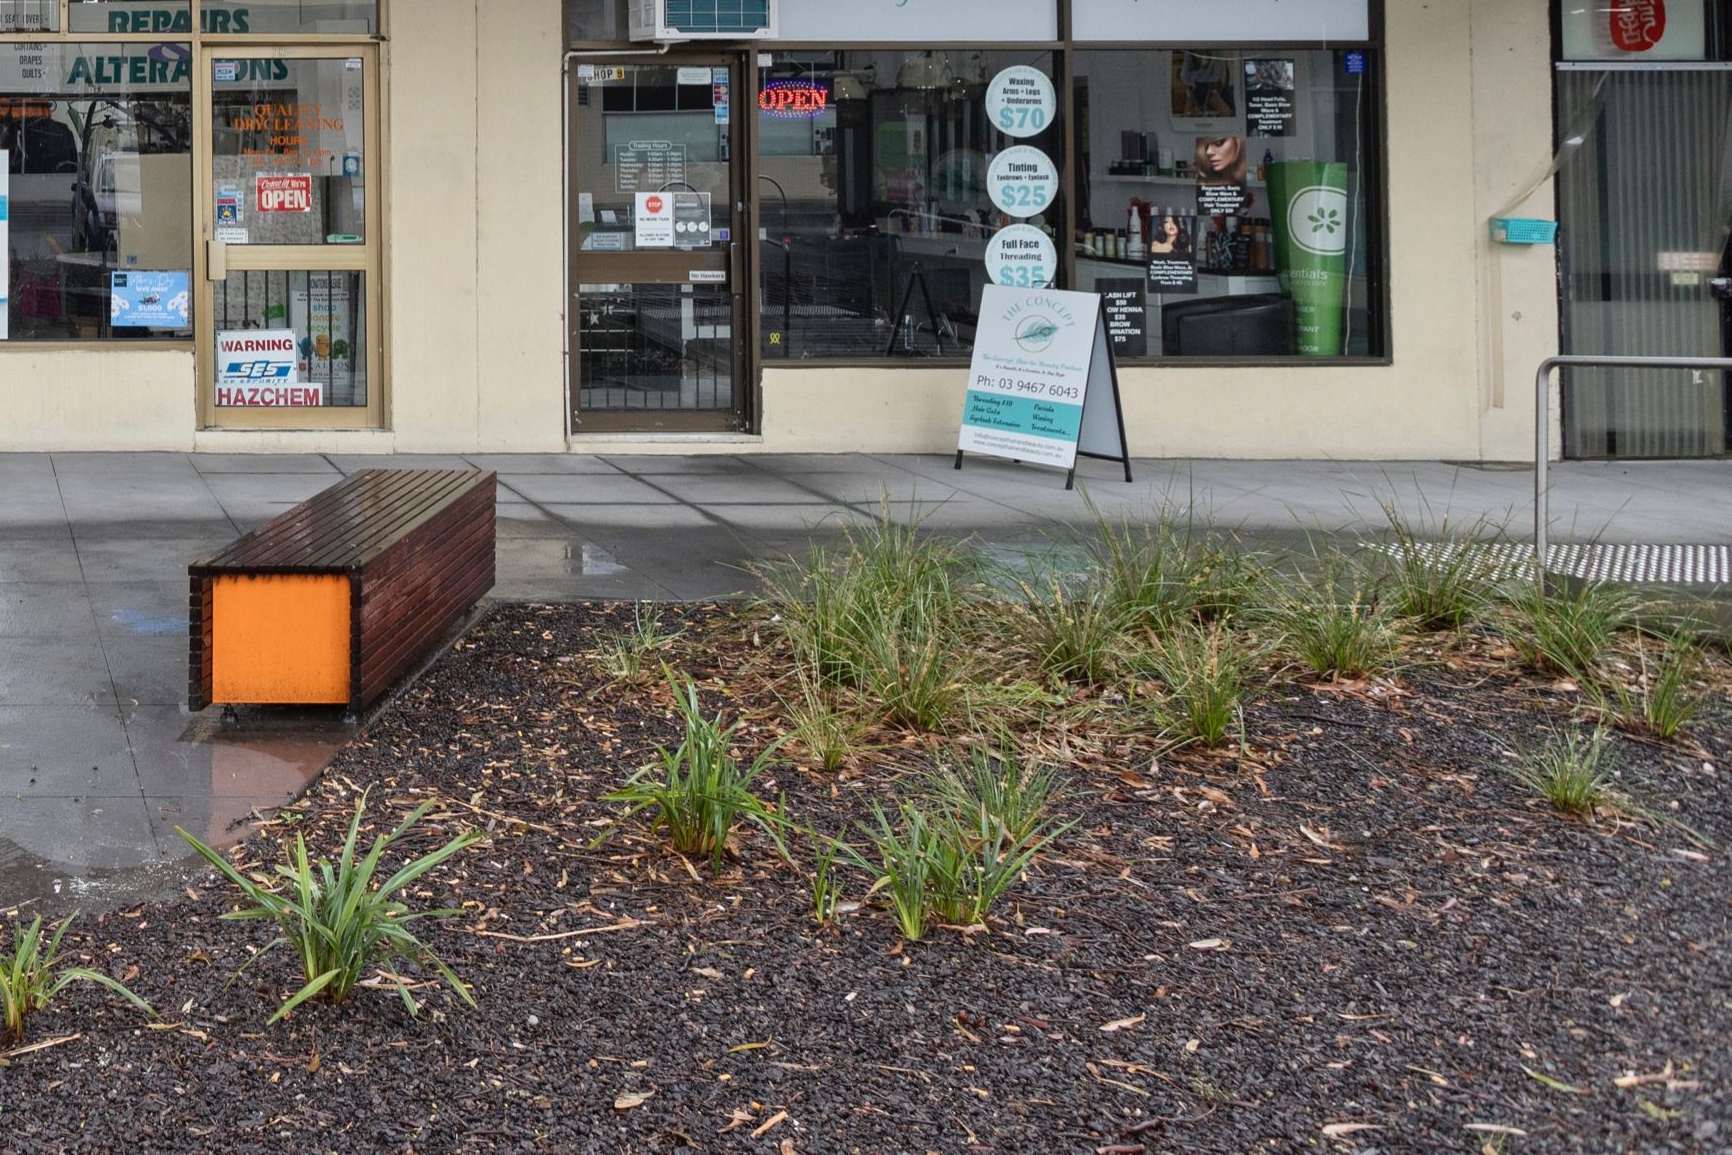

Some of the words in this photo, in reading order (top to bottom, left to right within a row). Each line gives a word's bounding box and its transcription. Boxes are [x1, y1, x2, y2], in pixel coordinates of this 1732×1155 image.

[19, 55, 42, 65] DRAPES
[22, 68, 42, 78] QUILTS
[1009, 78, 1034, 86] Waxing
[759, 89, 828, 111] OPEN
[999, 106, 1045, 130] $70
[1008, 163, 1038, 172] Tinting
[261, 190, 306, 209] OPEN
[1001, 184, 1047, 208] $25
[1002, 240, 1018, 248] Full
[1020, 240, 1039, 249] Face
[1000, 252, 1042, 261] Threading
[1000, 264, 1045, 288] $35
[220, 339, 293, 352] WARNING
[240, 361, 278, 378] SES
[977, 375, 994, 387] Ph:
[999, 378, 1013, 389] 03
[1017, 380, 1046, 394] 9467
[1049, 385, 1078, 398] 6043
[218, 388, 320, 406] HAZCHEM
